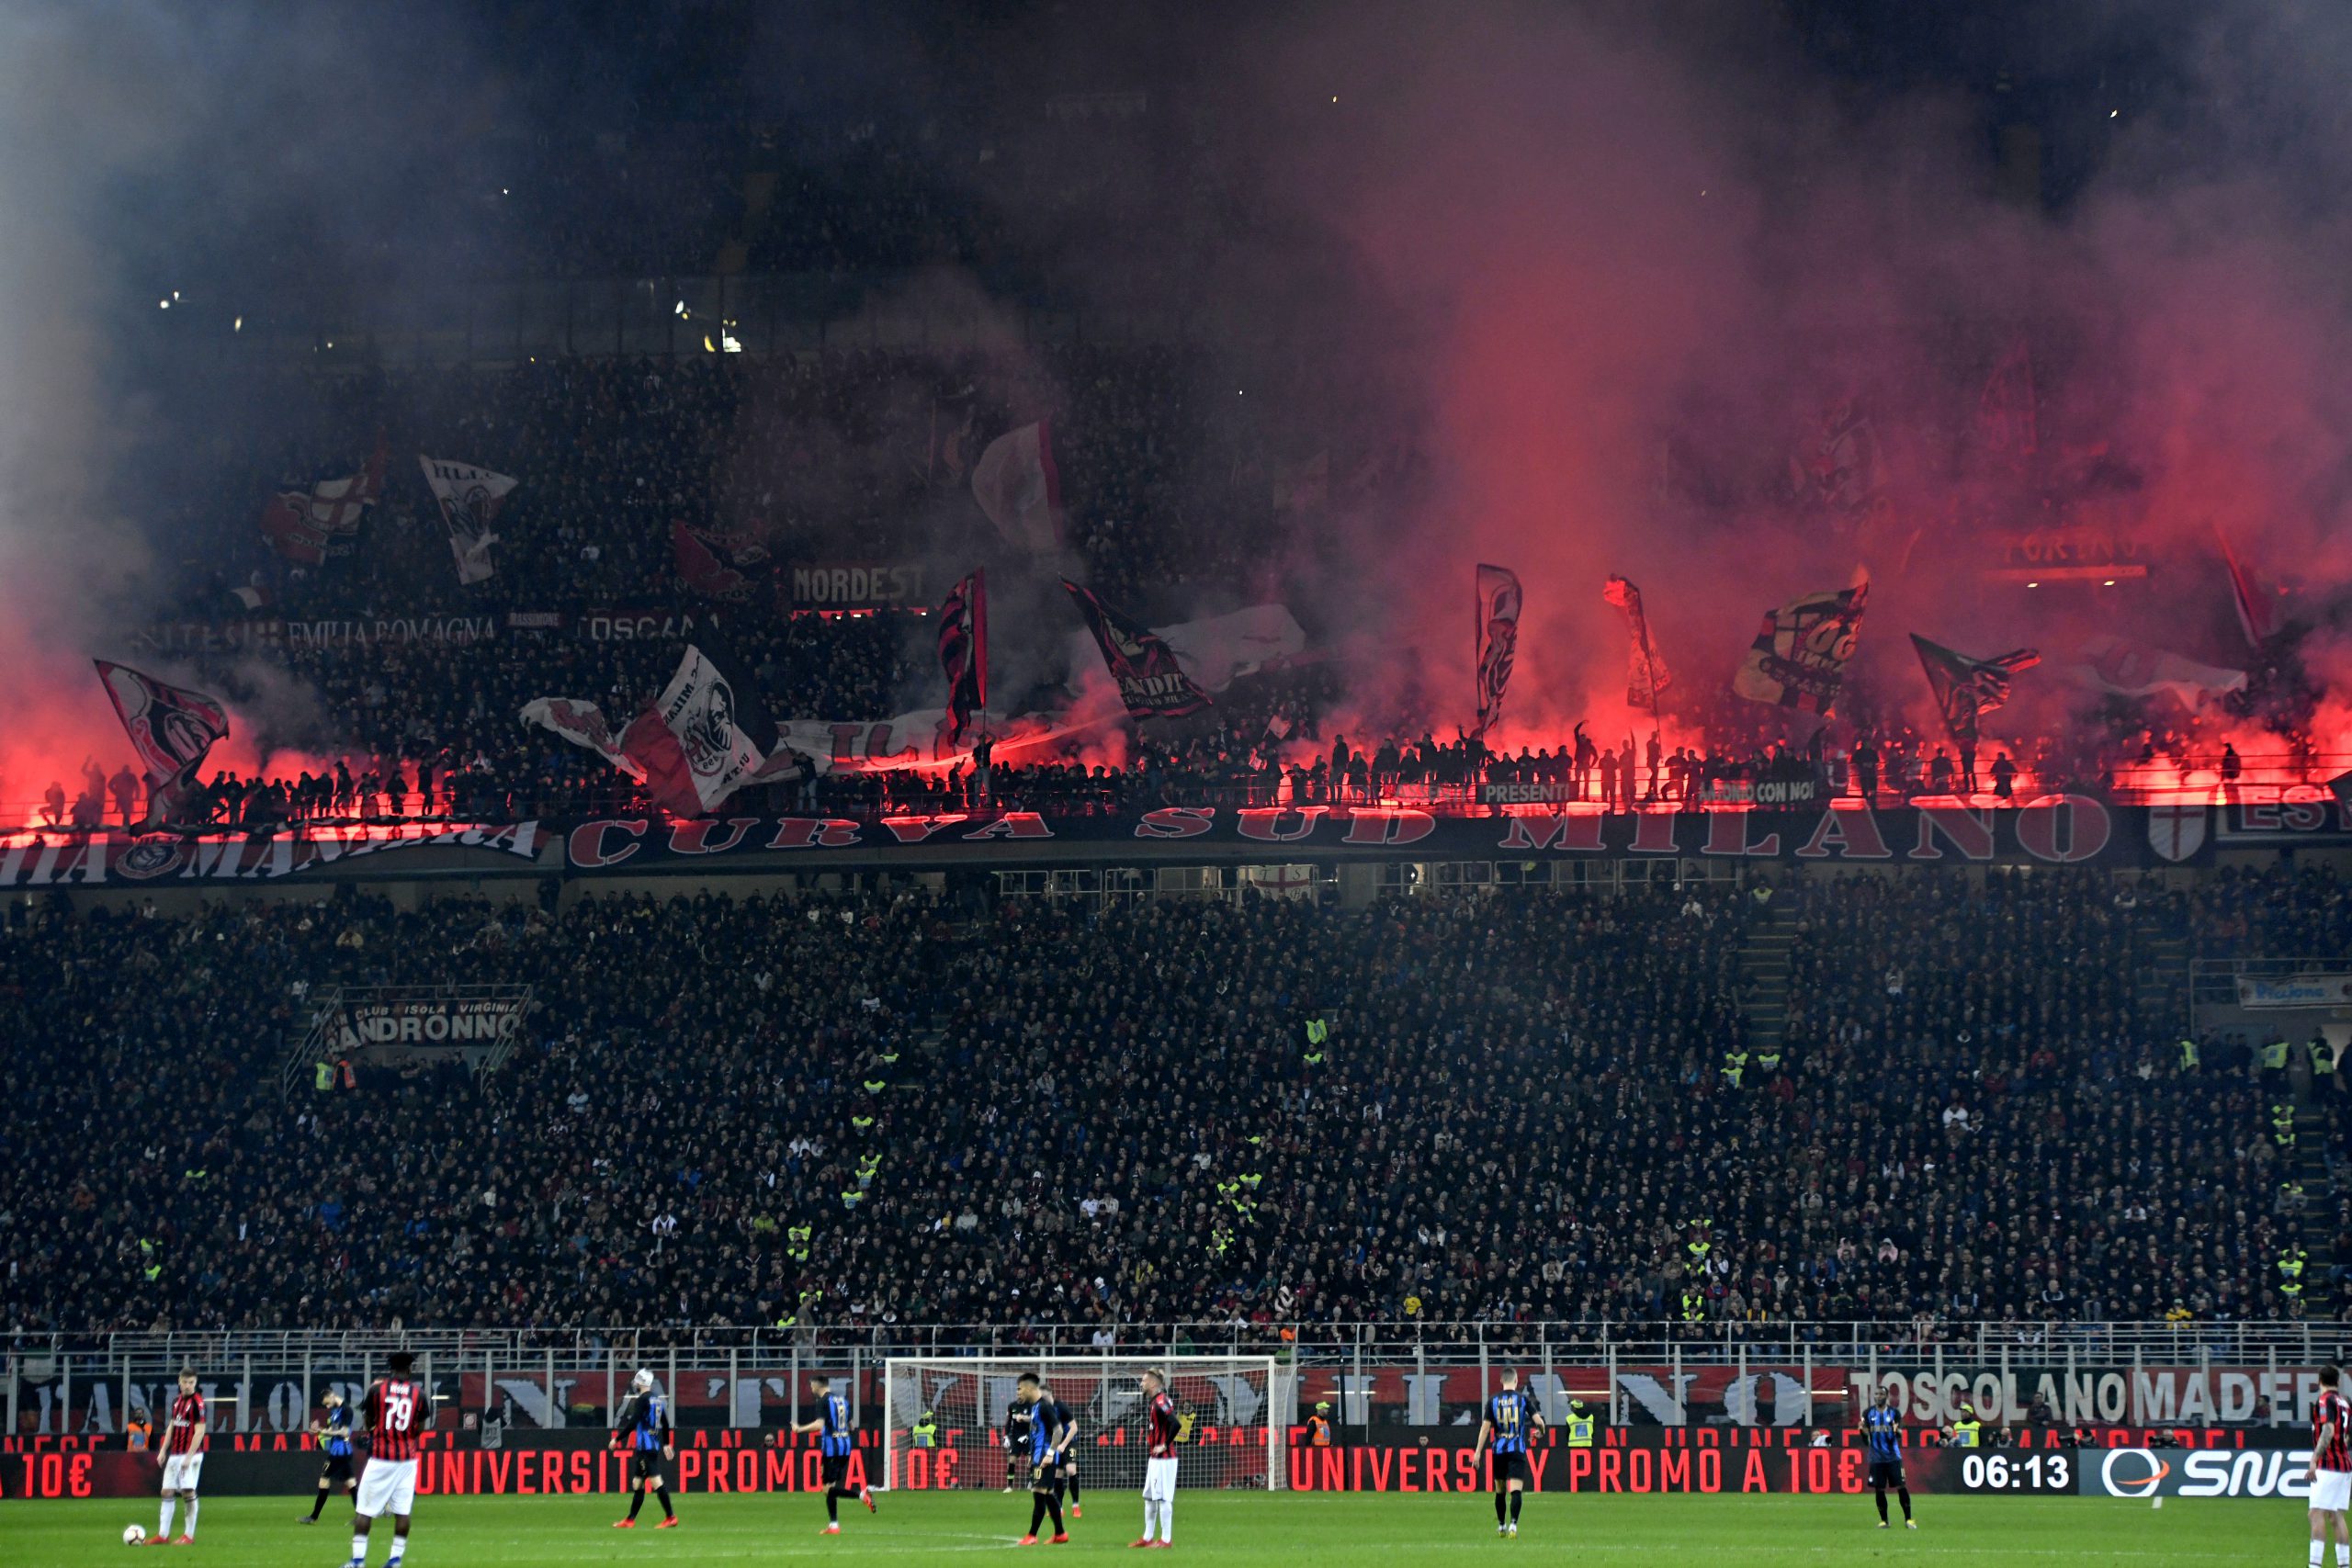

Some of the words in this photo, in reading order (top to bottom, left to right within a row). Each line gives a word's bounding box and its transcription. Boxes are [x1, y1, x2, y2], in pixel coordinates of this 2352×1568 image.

[793, 564, 923, 603] NORDEST
[1485, 784, 1570, 803] PRESENTI
[1757, 782, 1786, 802] CON
[1790, 781, 1816, 801] NOI
[569, 813, 1056, 868] CURVA
[1134, 805, 1436, 845] SUD
[1497, 794, 2111, 863] MILANO
[355, 1006, 390, 1021] CLUB
[401, 1004, 447, 1015] ISOLA
[459, 1003, 516, 1014] VIRGINIA
[384, 1396, 413, 1432] 79
[1497, 1406, 1519, 1432] 44
[22, 1454, 92, 1498] 10€
[679, 1449, 824, 1493] PROMO
[844, 1449, 867, 1490] A
[889, 1448, 958, 1490] 10€
[1034, 1468, 1042, 1480] 10
[1292, 1447, 1549, 1493] UNIVERSIY
[1570, 1449, 1722, 1493] PROMO
[1742, 1449, 1768, 1493] A
[1786, 1449, 1863, 1494] 10€
[1962, 1454, 2070, 1488] 06:13
